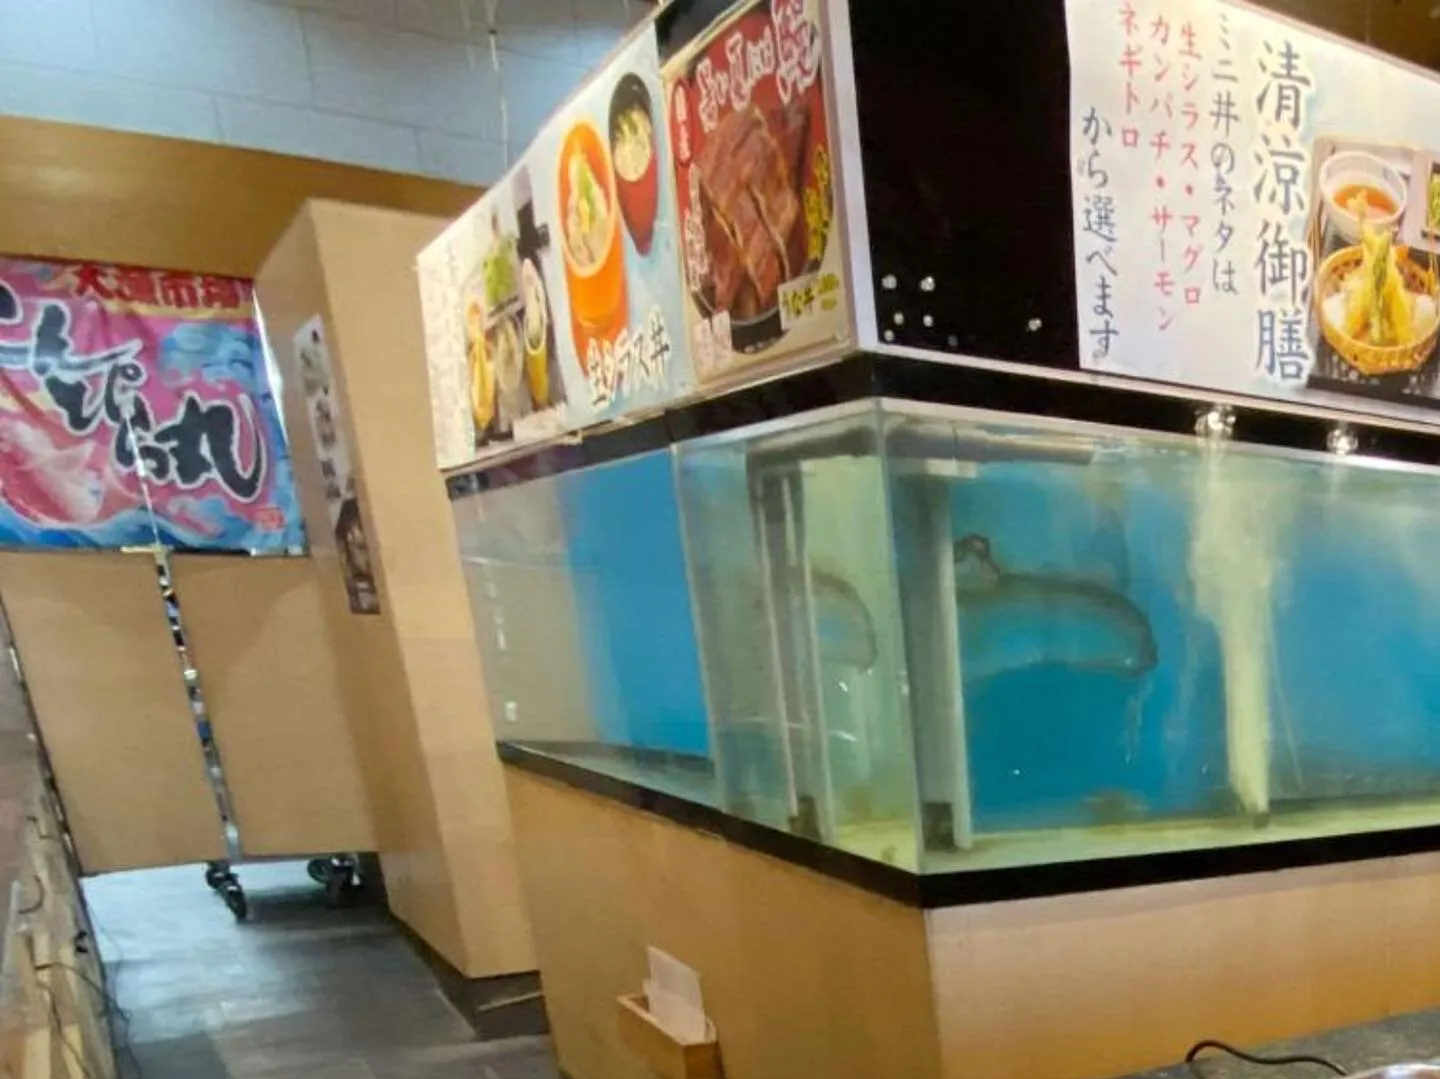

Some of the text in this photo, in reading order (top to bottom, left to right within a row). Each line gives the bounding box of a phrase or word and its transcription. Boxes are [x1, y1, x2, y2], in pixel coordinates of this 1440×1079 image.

[1118, 0, 1143, 149] ネギトロ
[1078, 106, 1120, 362] から選べます
[1253, 40, 1312, 381] 清涼御膳
